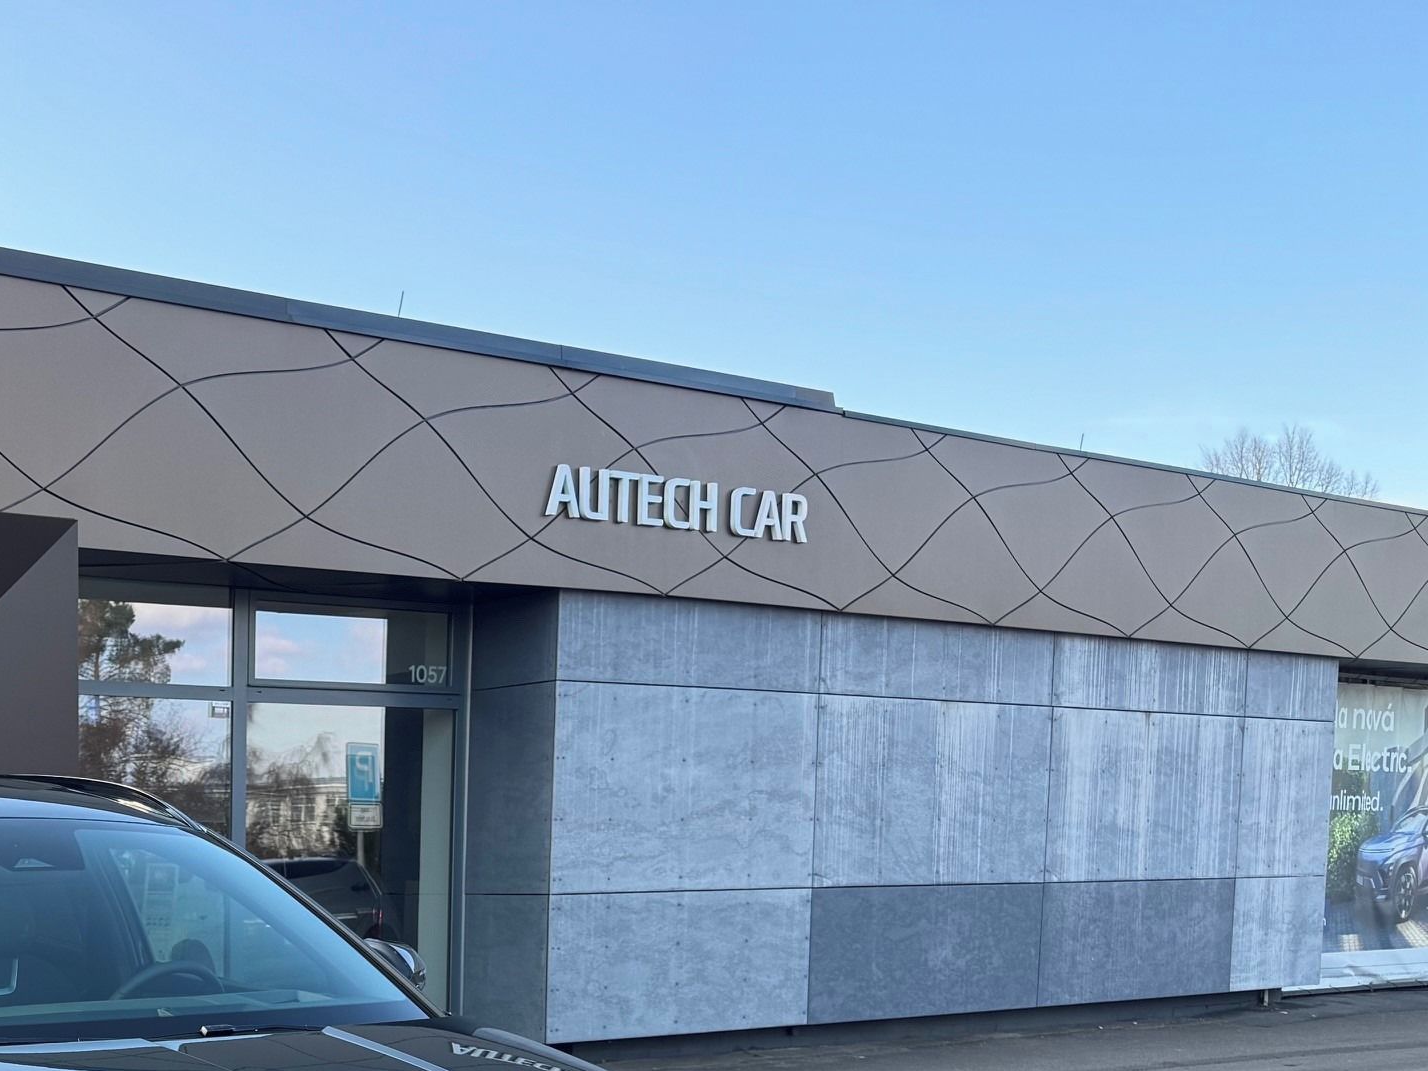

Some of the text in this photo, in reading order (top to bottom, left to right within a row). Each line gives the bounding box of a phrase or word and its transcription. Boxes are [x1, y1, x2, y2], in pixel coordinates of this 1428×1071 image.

[545, 464, 808, 543] AUTECH CAR
[408, 664, 448, 684] 1057
[1352, 703, 1395, 732] nová
[1329, 789, 1384, 812] nlimited.
